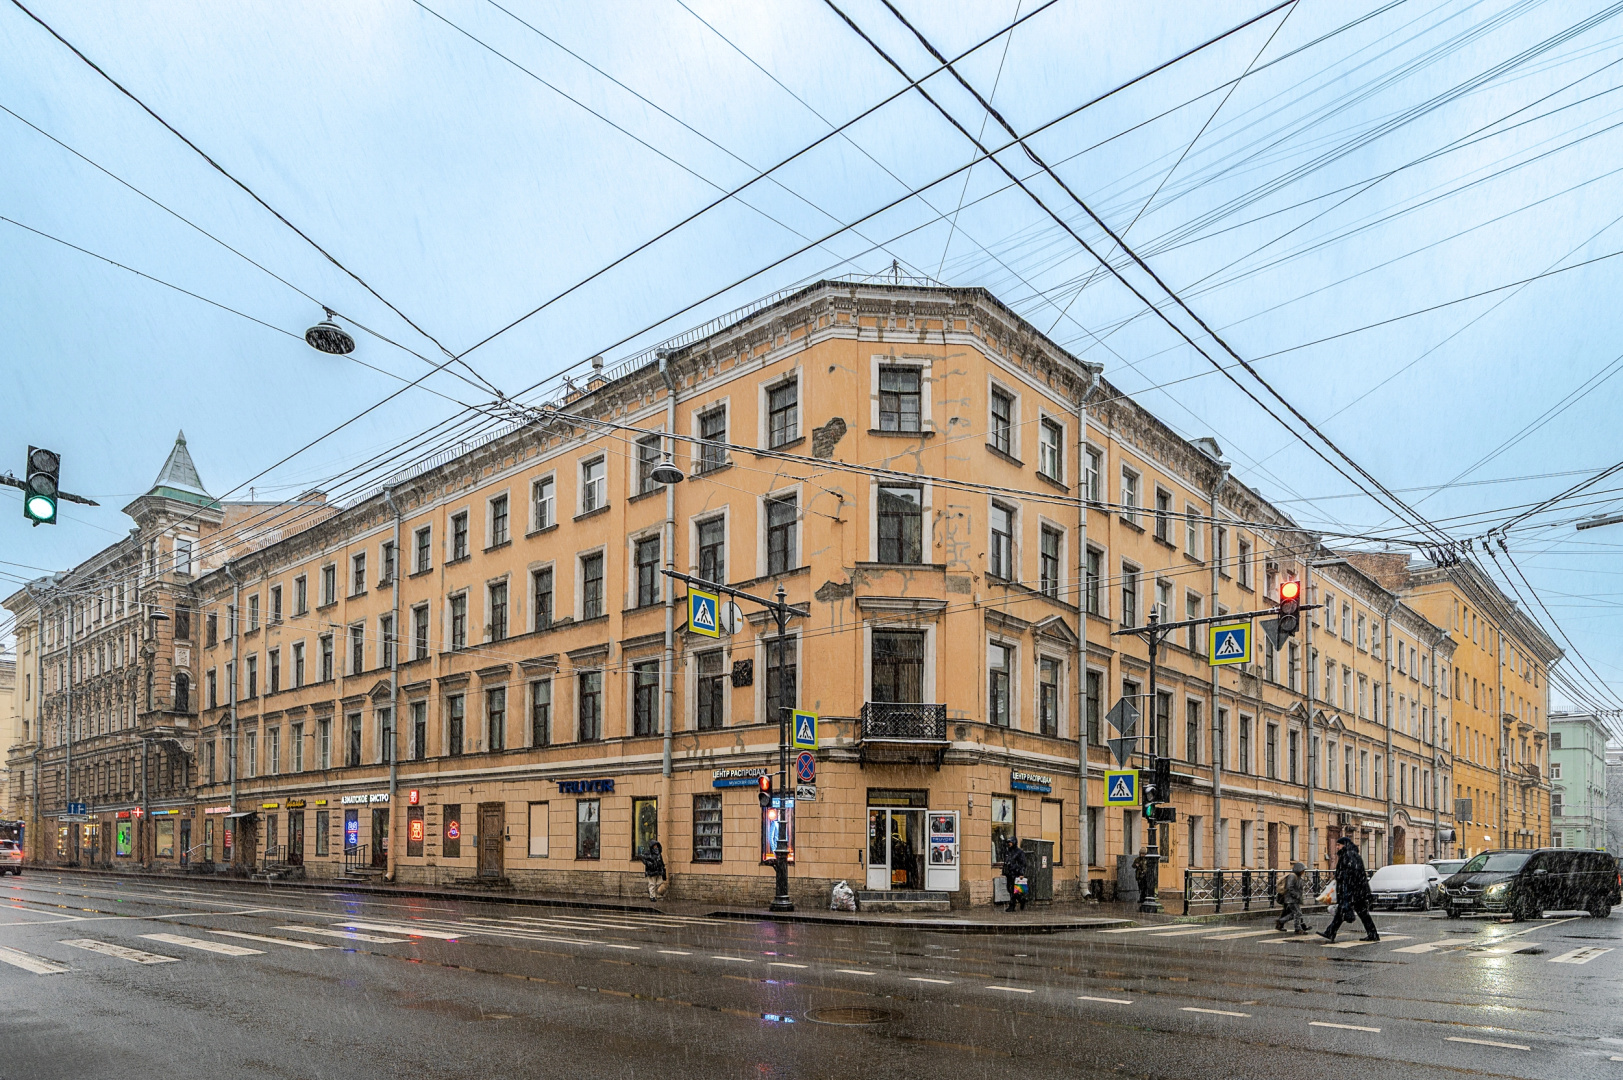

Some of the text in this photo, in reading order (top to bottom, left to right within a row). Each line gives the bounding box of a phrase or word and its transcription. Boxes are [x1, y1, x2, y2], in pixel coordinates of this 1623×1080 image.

[713, 768, 766, 779] ЦЕНТР РАСПРОДАЖ
[1012, 772, 1052, 784] ЦЕНТР РАСПРОДАЖ
[556, 779, 615, 794] TRUVOR
[341, 793, 389, 804] АЗИАТСКОЕ БИСТРО
